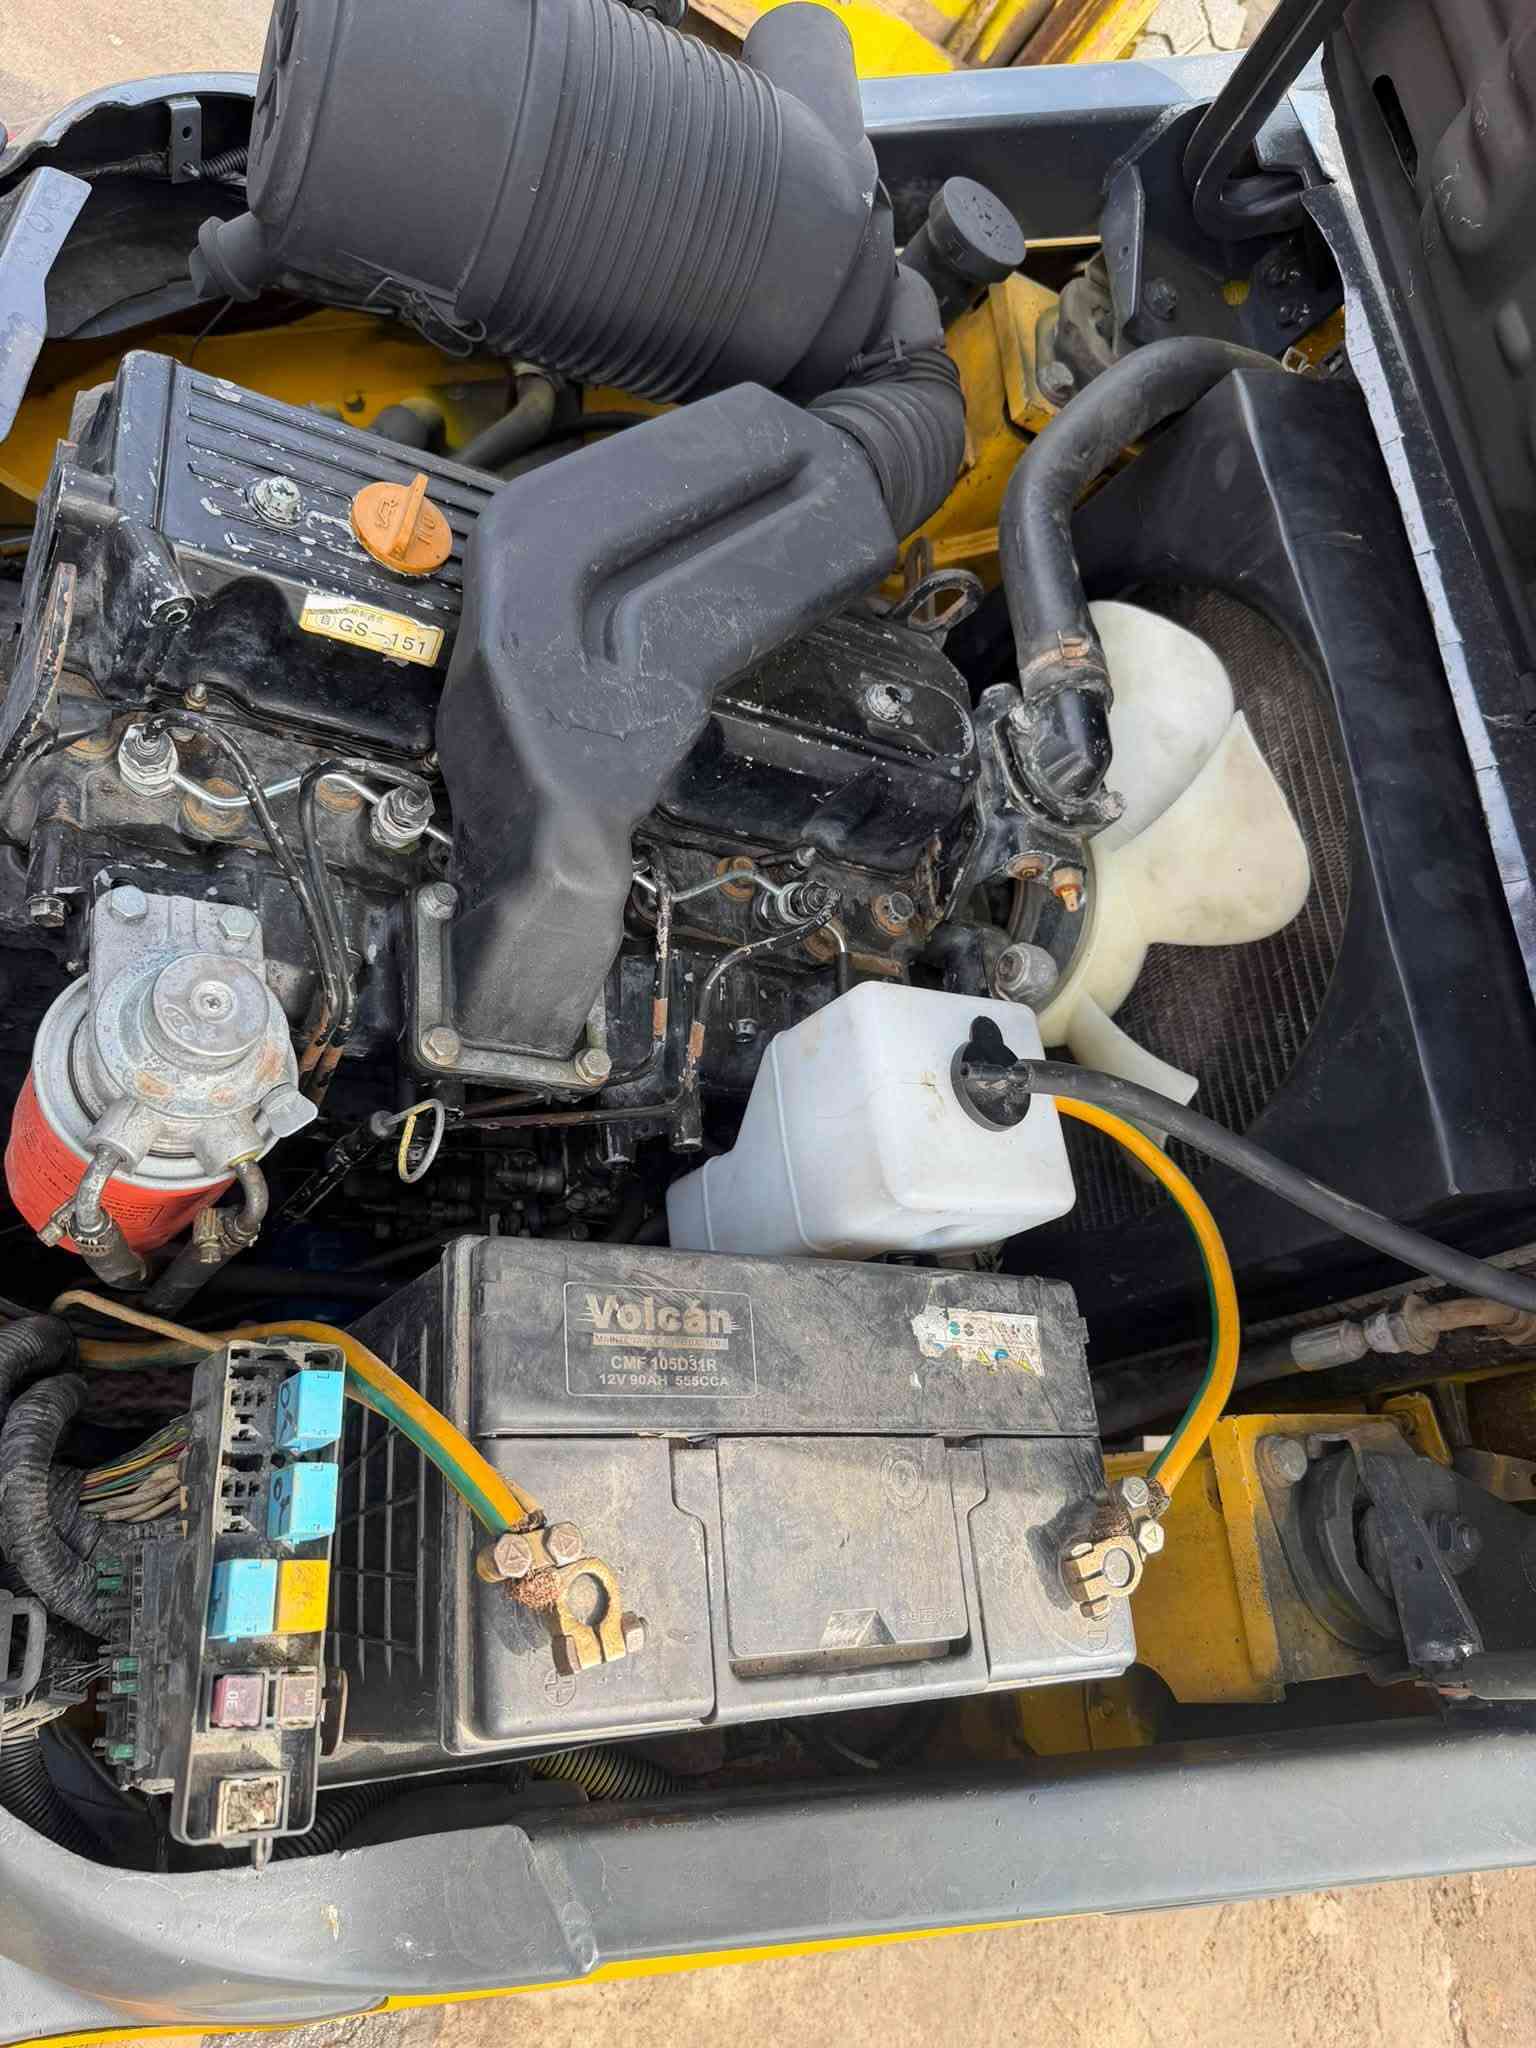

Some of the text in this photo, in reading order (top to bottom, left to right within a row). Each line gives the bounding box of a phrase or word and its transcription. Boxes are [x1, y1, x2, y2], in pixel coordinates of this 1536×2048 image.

[610, 1355, 718, 1372] CMF 105D31R
[599, 1374, 729, 1387] 12V 90AH 555CCA
